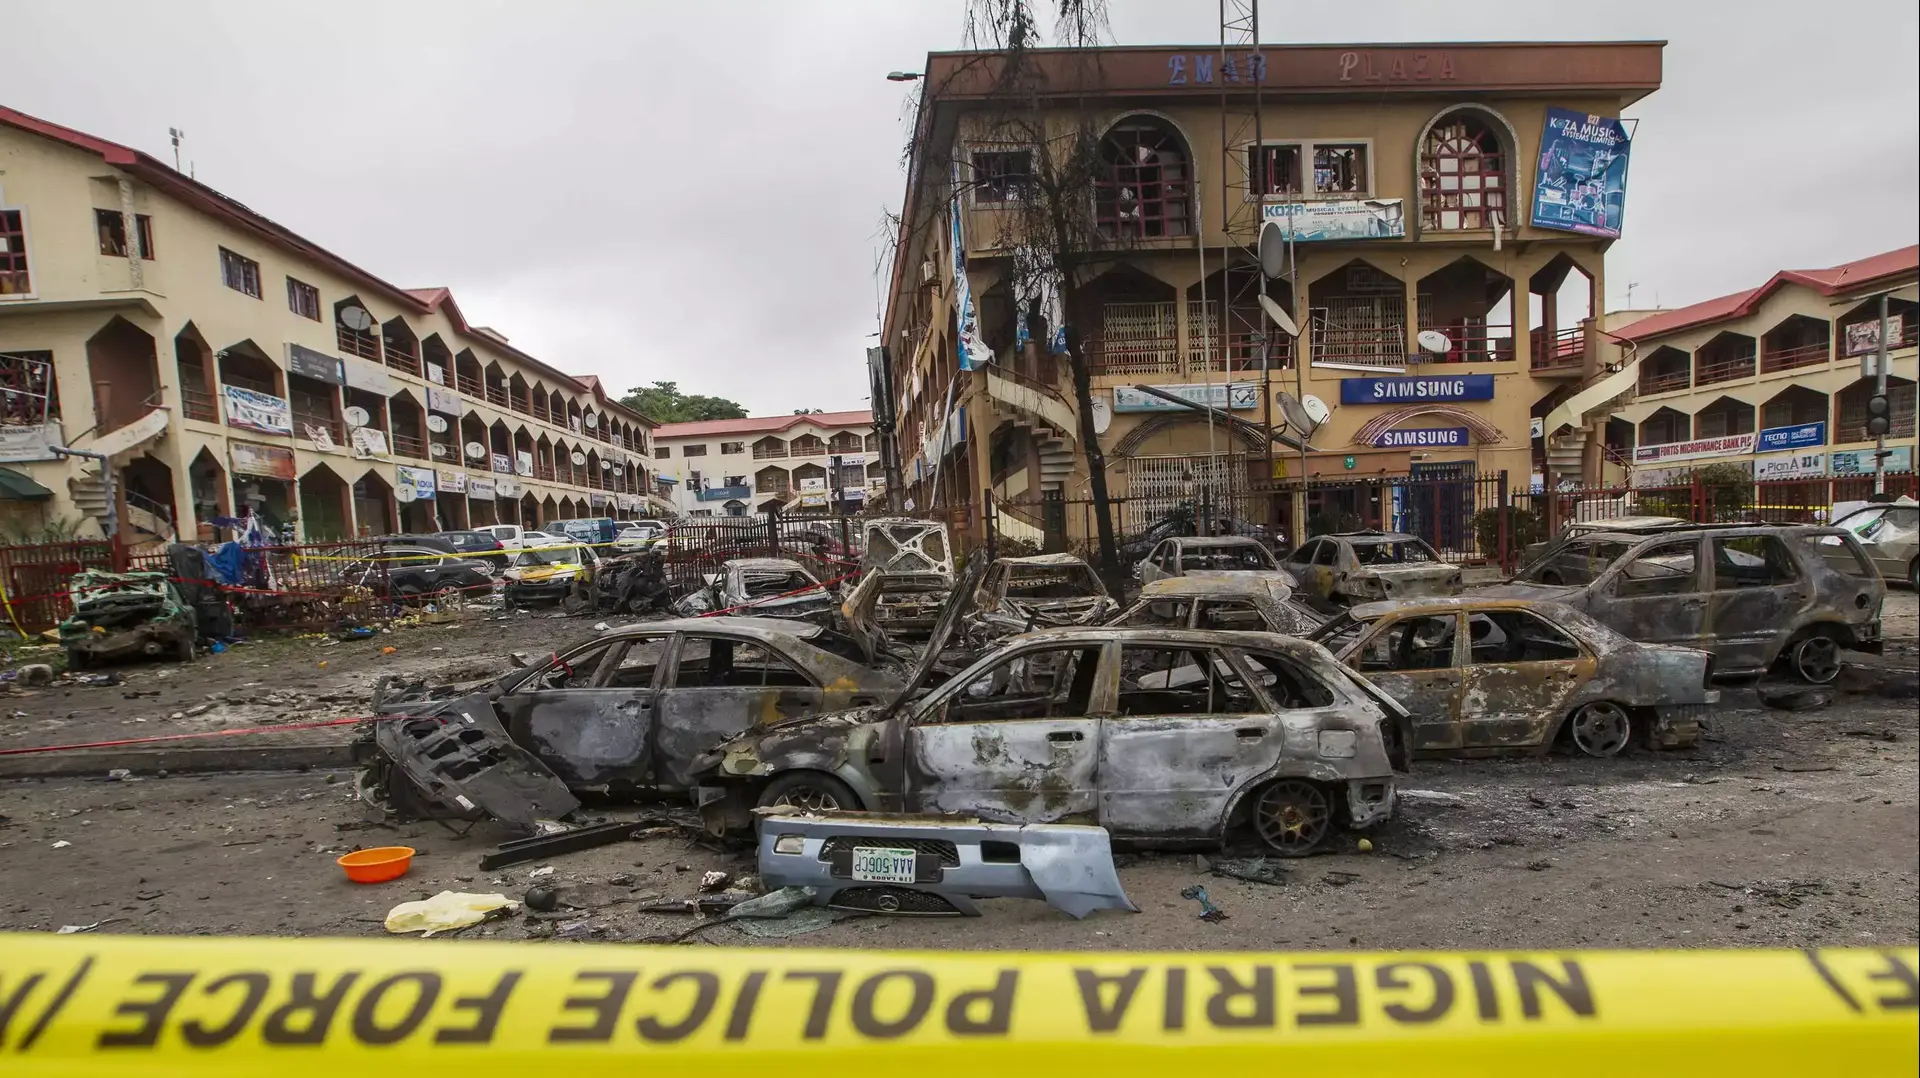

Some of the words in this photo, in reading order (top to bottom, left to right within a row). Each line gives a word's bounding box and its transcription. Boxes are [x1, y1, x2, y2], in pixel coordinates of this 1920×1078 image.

[1168, 53, 1266, 84] EMAB
[1340, 52, 1457, 82] PLAZA
[1562, 129, 1589, 141] SYSTEMS
[1590, 136, 1615, 146] LIMITED
[1264, 204, 1304, 217] KOZA
[1373, 380, 1465, 398] SAMSUNG
[1384, 430, 1459, 445] SAMSUNG
[1764, 432, 1788, 441] TECNO
[1660, 445, 1679, 457] FORTIS
[1680, 440, 1721, 455] MICROFINANCE
[1722, 437, 1740, 450] BANK
[1768, 462, 1789, 472] Plan
[1790, 457, 1799, 470] A
[1075, 959, 1597, 1034] NIGERIA
[91, 970, 523, 1055] FORCE
[546, 969, 1019, 1046] POLICE
